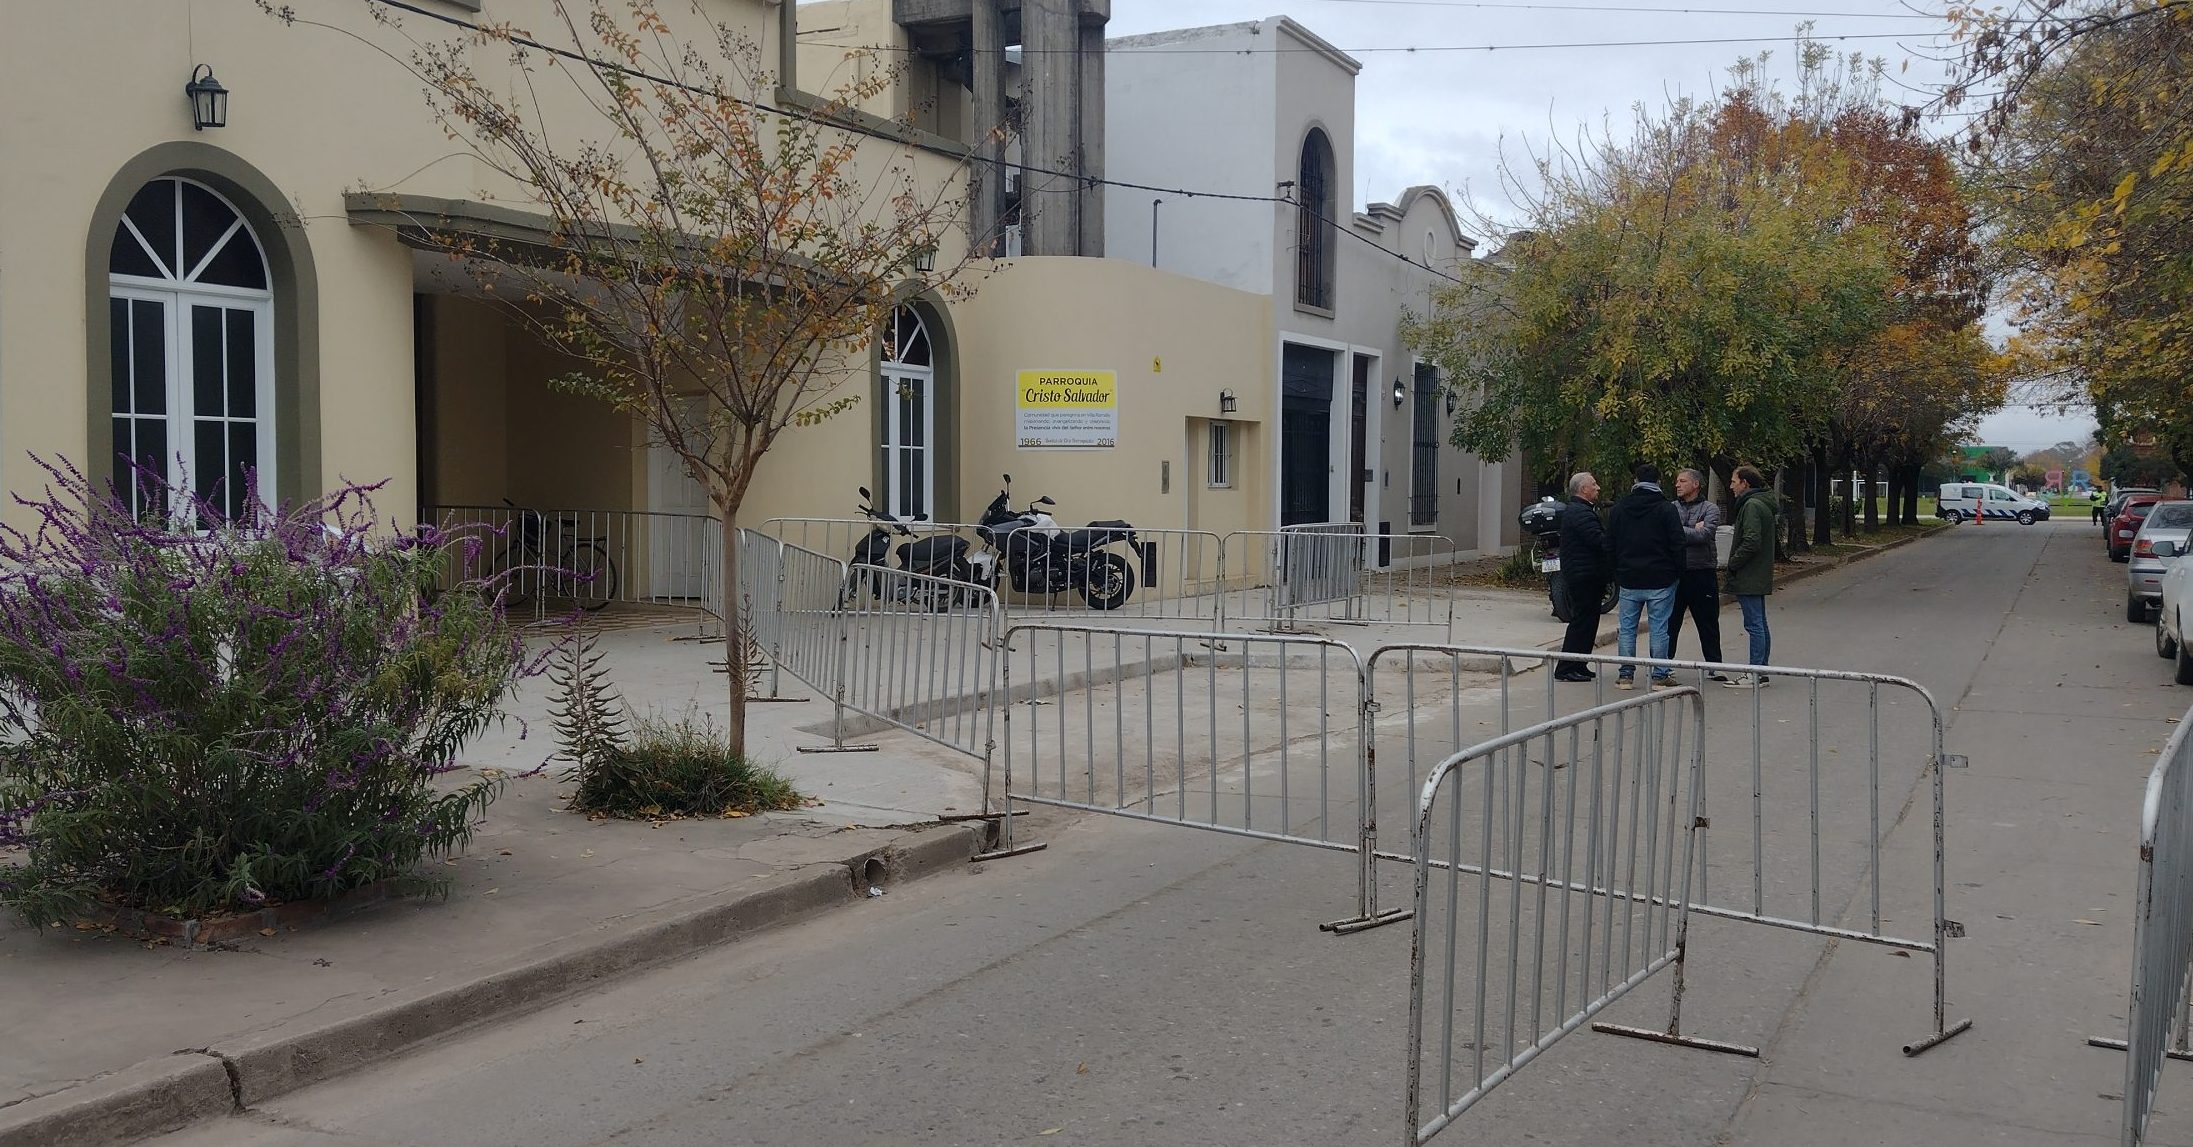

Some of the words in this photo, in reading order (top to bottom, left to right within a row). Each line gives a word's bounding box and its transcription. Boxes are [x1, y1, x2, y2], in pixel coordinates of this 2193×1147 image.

[1039, 377, 1098, 385] PARROQUIA
[1020, 437, 1042, 446] 1966
[1097, 437, 1115, 446] 2016
